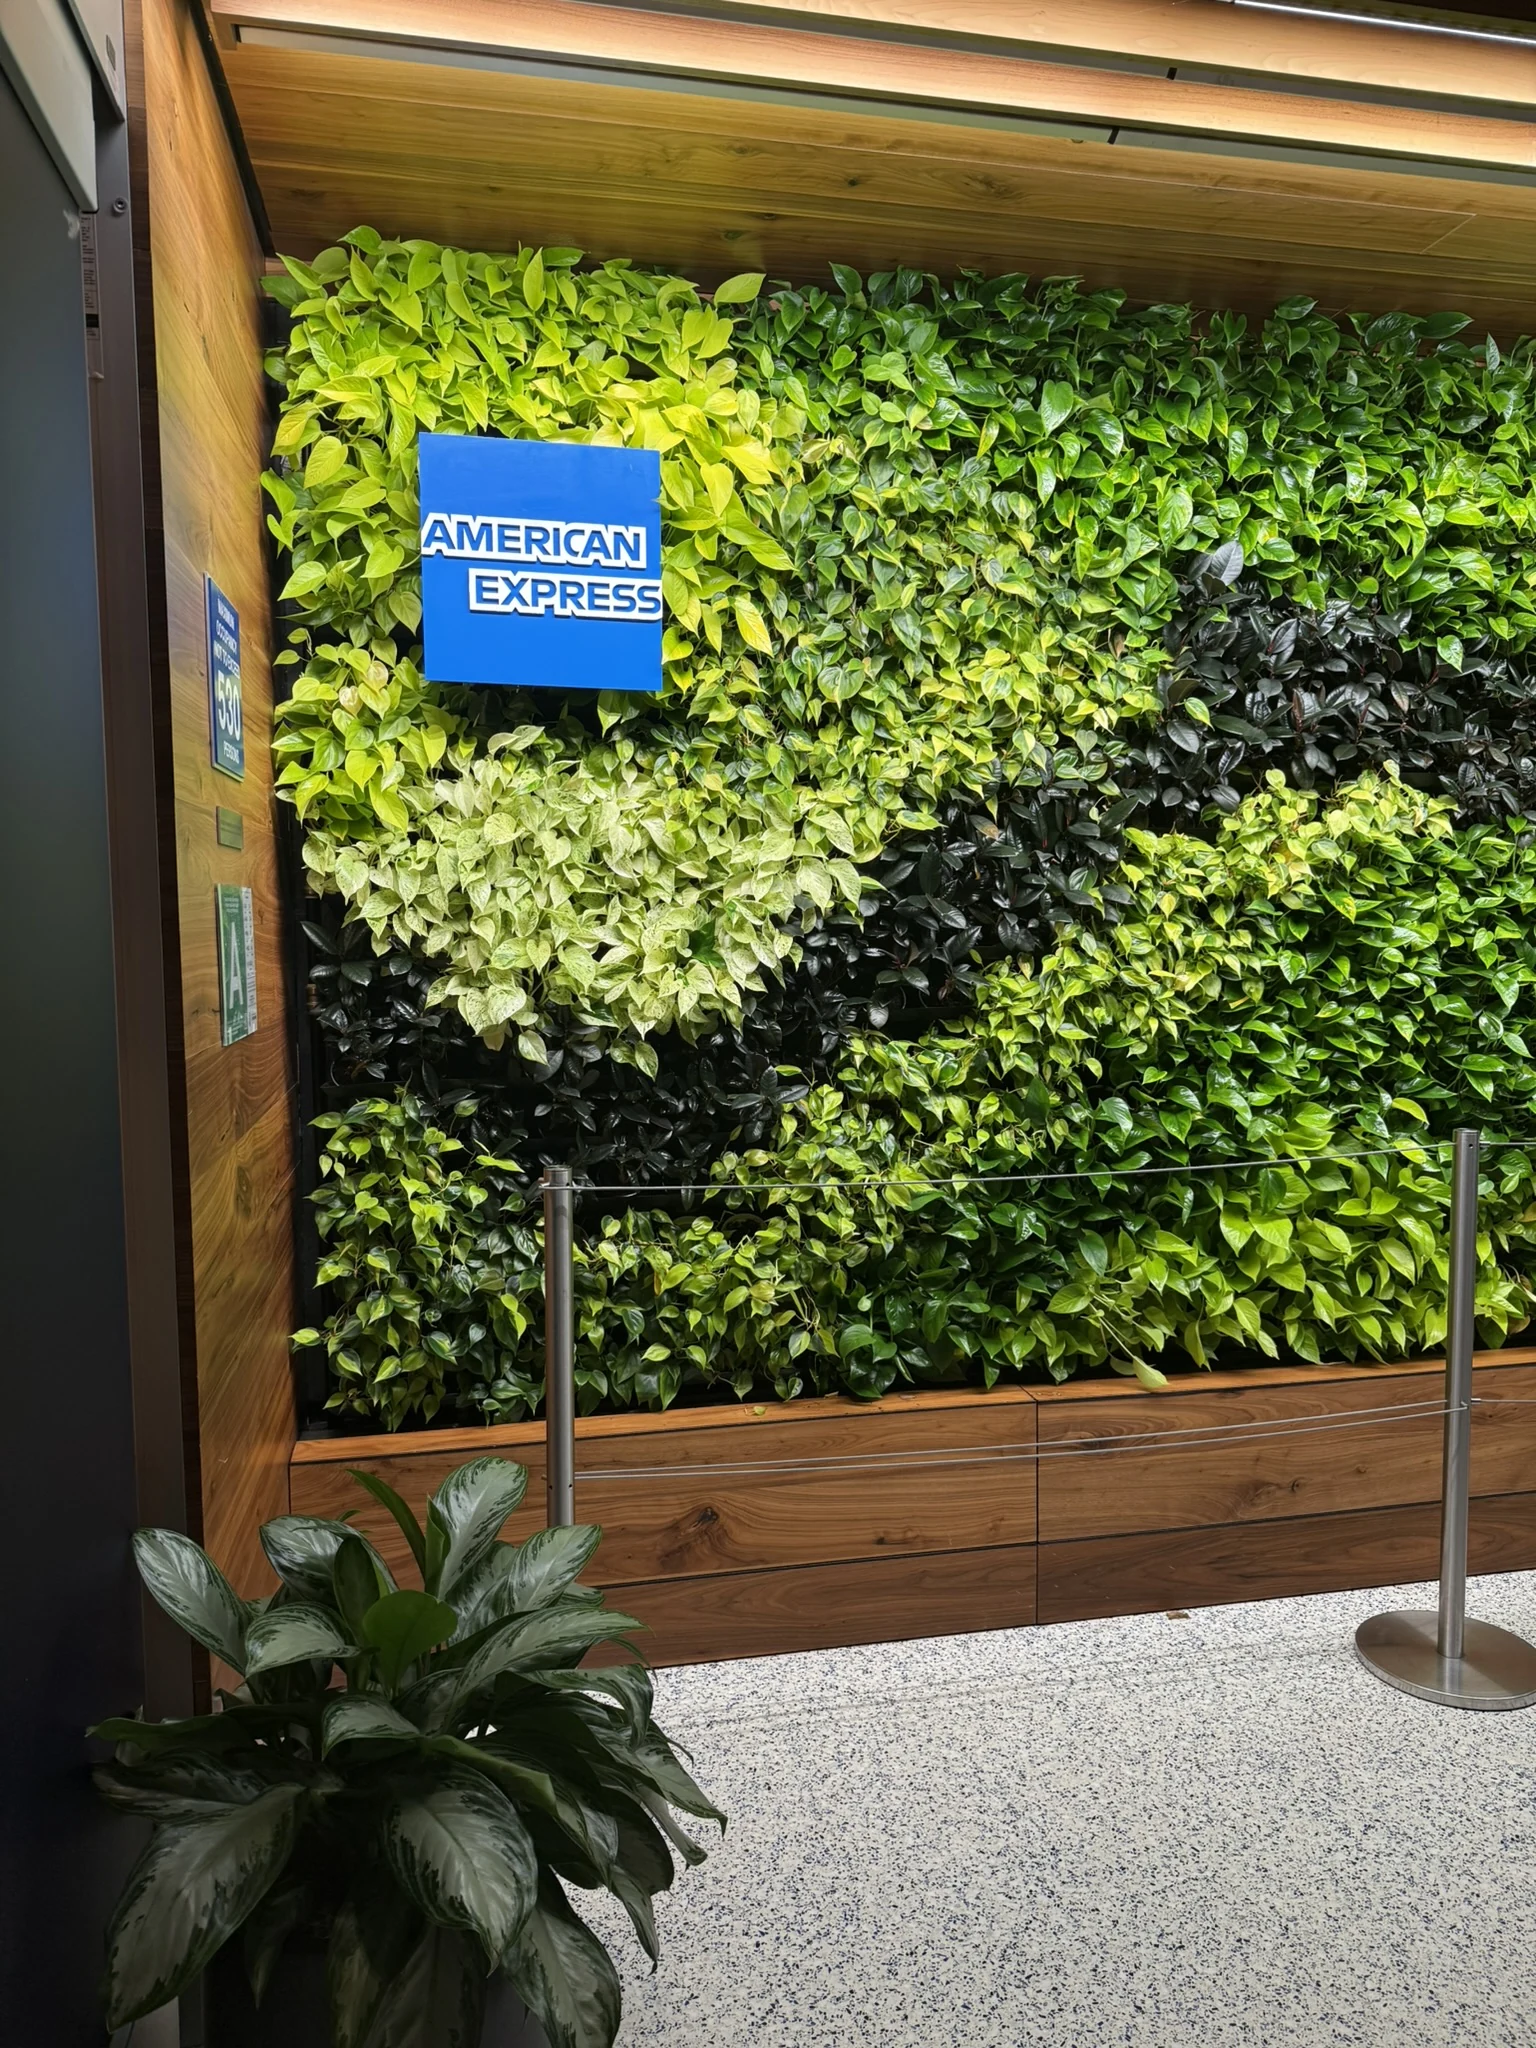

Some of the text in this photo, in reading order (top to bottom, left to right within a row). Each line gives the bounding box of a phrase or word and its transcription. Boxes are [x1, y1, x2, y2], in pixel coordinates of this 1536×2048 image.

[421, 512, 646, 569] AMERICAN
[468, 568, 662, 621] EXPRESS
[218, 669, 241, 741] 530
[223, 740, 240, 764] PERSONS
[229, 922, 244, 1010] A
